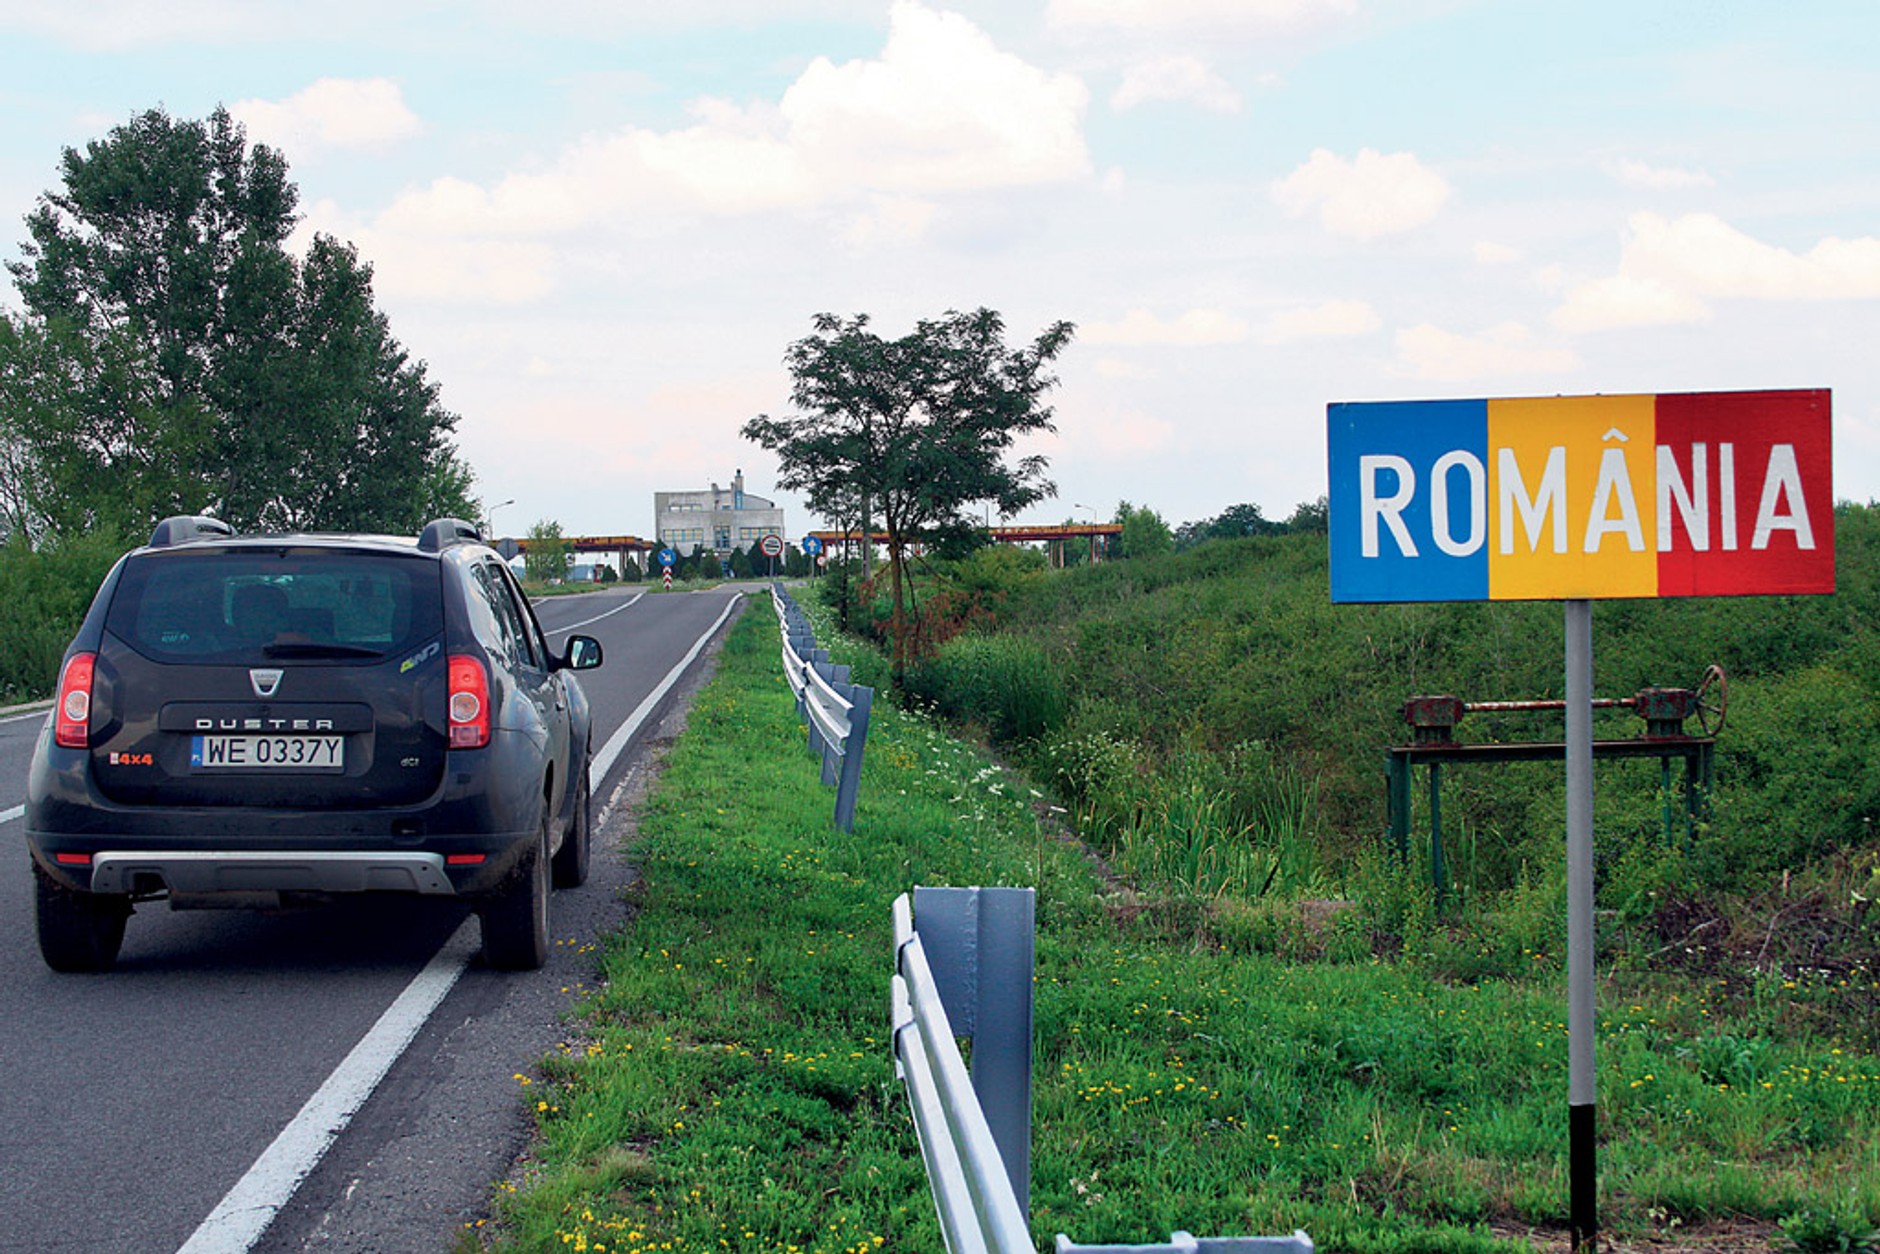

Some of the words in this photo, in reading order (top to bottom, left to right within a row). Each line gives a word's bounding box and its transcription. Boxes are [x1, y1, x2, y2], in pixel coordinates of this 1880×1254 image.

[1360, 428, 1815, 557] ROMÂNIA
[196, 719, 333, 730] DUSTER
[208, 739, 245, 763] WE
[257, 738, 340, 764] 0337Y
